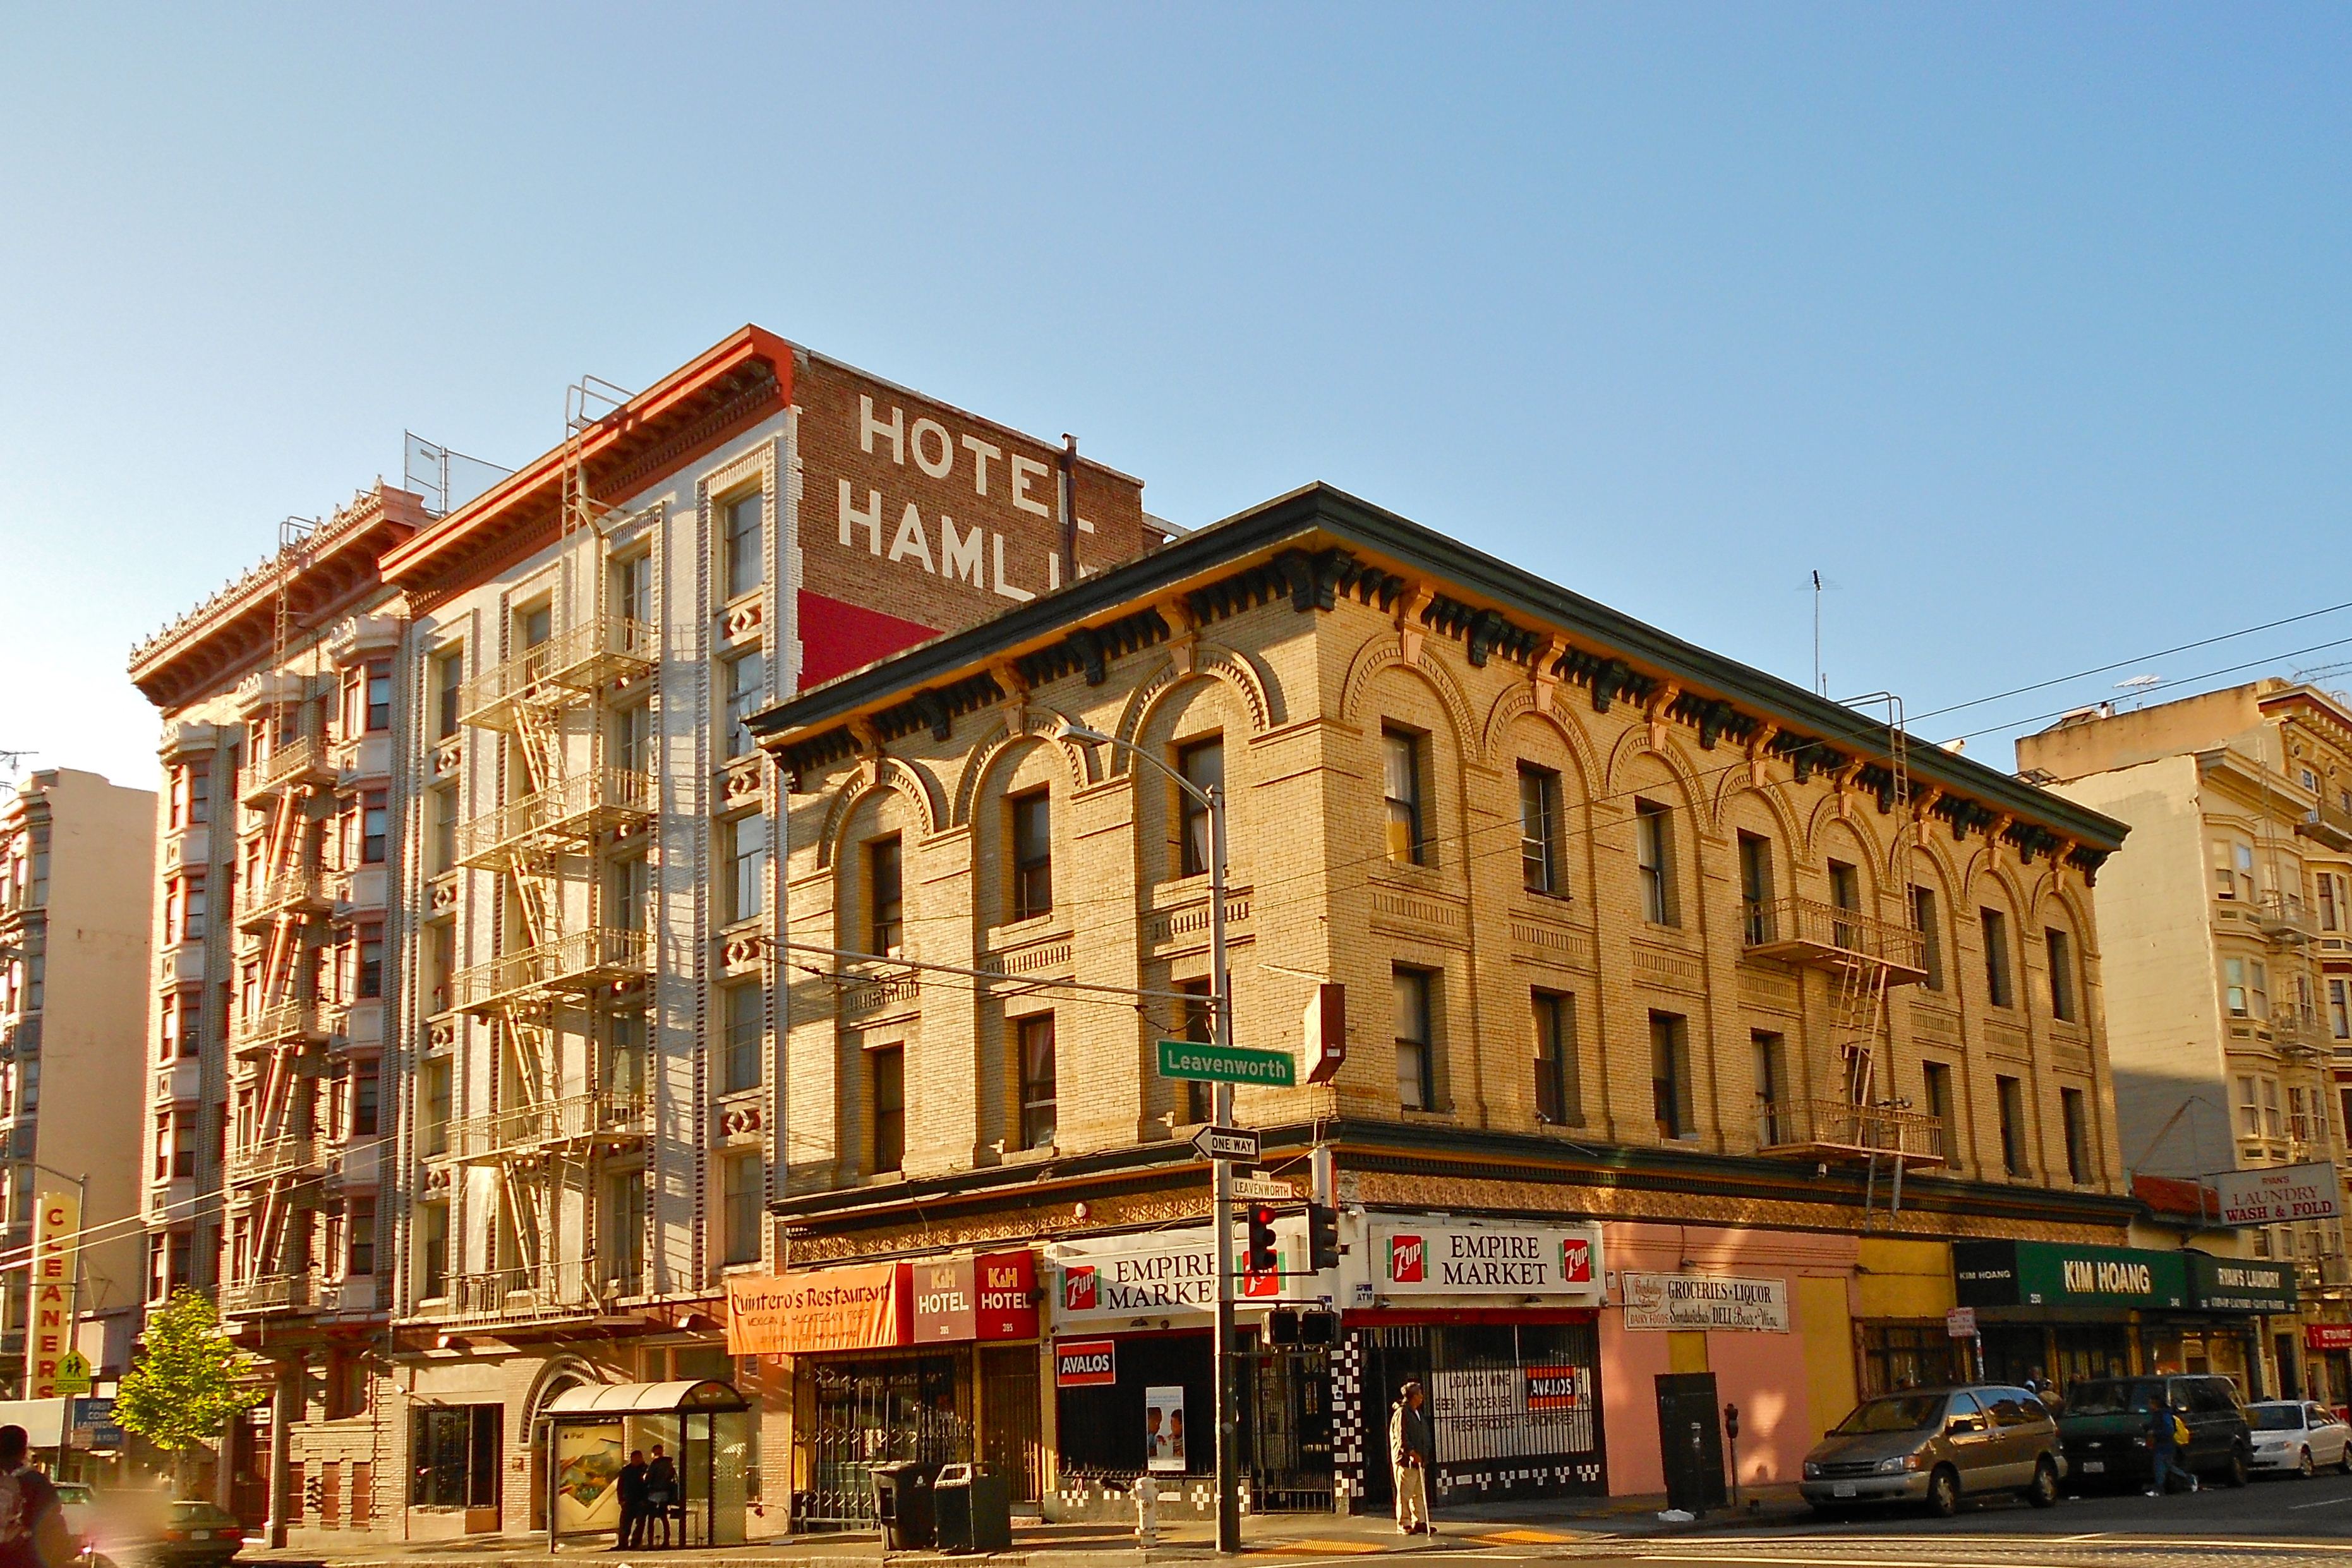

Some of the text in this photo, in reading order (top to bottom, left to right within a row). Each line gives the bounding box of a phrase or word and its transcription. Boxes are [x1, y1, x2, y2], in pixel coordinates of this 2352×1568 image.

[860, 394, 1094, 534] HOTEL
[839, 478, 1099, 601] HAMLI
[1168, 1049, 1286, 1078] Leavenworth
[1212, 1137, 1252, 1152] ONE WAY
[1234, 1181, 1289, 1197] LEAVENWORTH
[2233, 1185, 2318, 1206] LAUNDRY
[2225, 1201, 2332, 1222] WASH & FOLD
[1449, 1235, 1540, 1259] EMPIRE
[1442, 1262, 1548, 1286] MARKET
[1979, 1270, 2011, 1279] HOANG
[2064, 1260, 2151, 1294] KIM HOANG
[732, 1280, 891, 1317] Quintero's Restaurant
[919, 1292, 970, 1314] HOTEL
[981, 1293, 1032, 1310] HOTEL
[1107, 1280, 1215, 1310] MARKE
[1357, 1293, 1373, 1301] ATM
[1667, 1281, 1772, 1306] GROCERIES LIQUOR
[847, 1308, 869, 1322] FOOD
[1649, 1313, 1669, 1324] FOODS
[1713, 1308, 1732, 1324] DELI
[1734, 1306, 1754, 1325] Beer
[1061, 1354, 1109, 1374] AVALOS
[56, 1382, 88, 1391] SCHOOL
